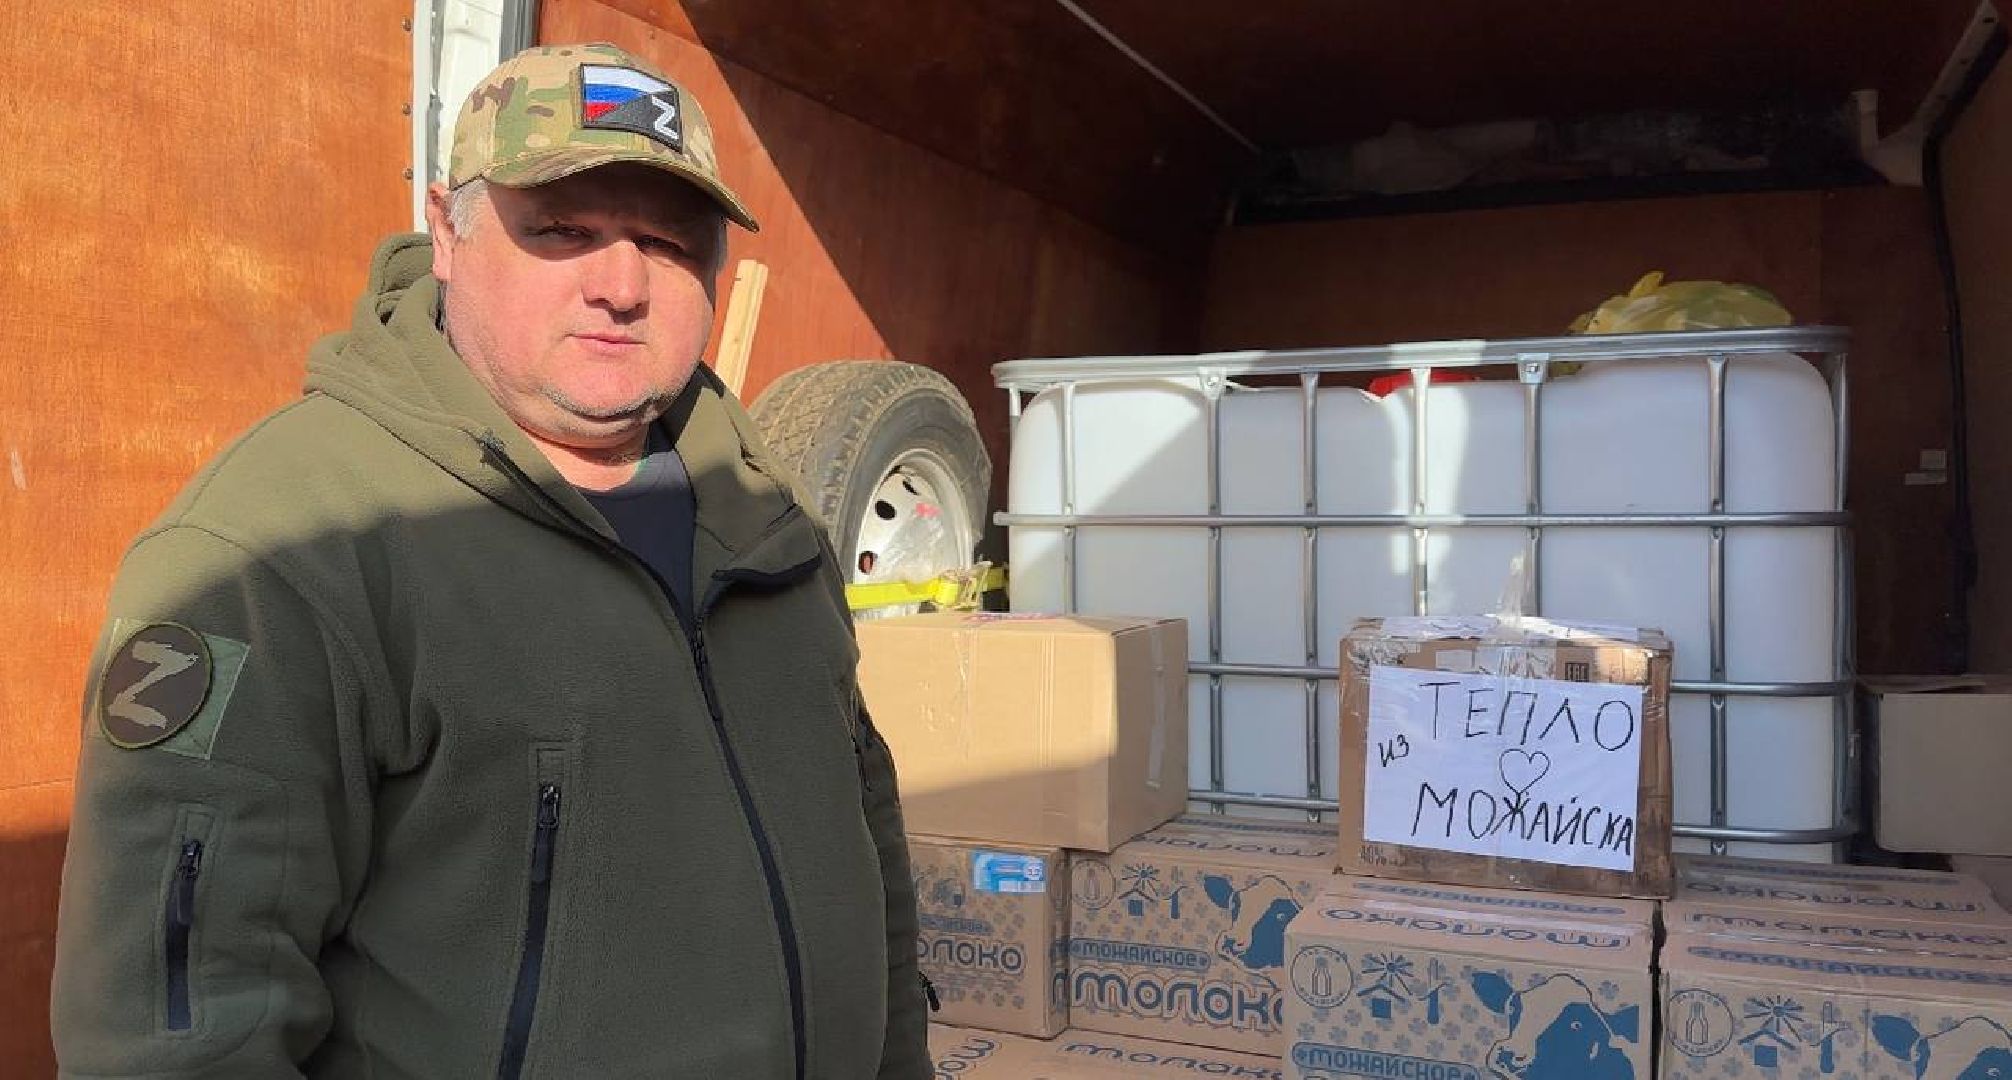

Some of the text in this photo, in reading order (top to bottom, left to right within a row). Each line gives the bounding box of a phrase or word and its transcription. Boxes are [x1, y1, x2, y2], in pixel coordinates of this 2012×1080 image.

[651, 94, 678, 140] Z
[108, 641, 198, 729] Z
[1419, 682, 1634, 752] ТЕПЛО
[1412, 782, 1634, 856] МОЖАЙСКА
